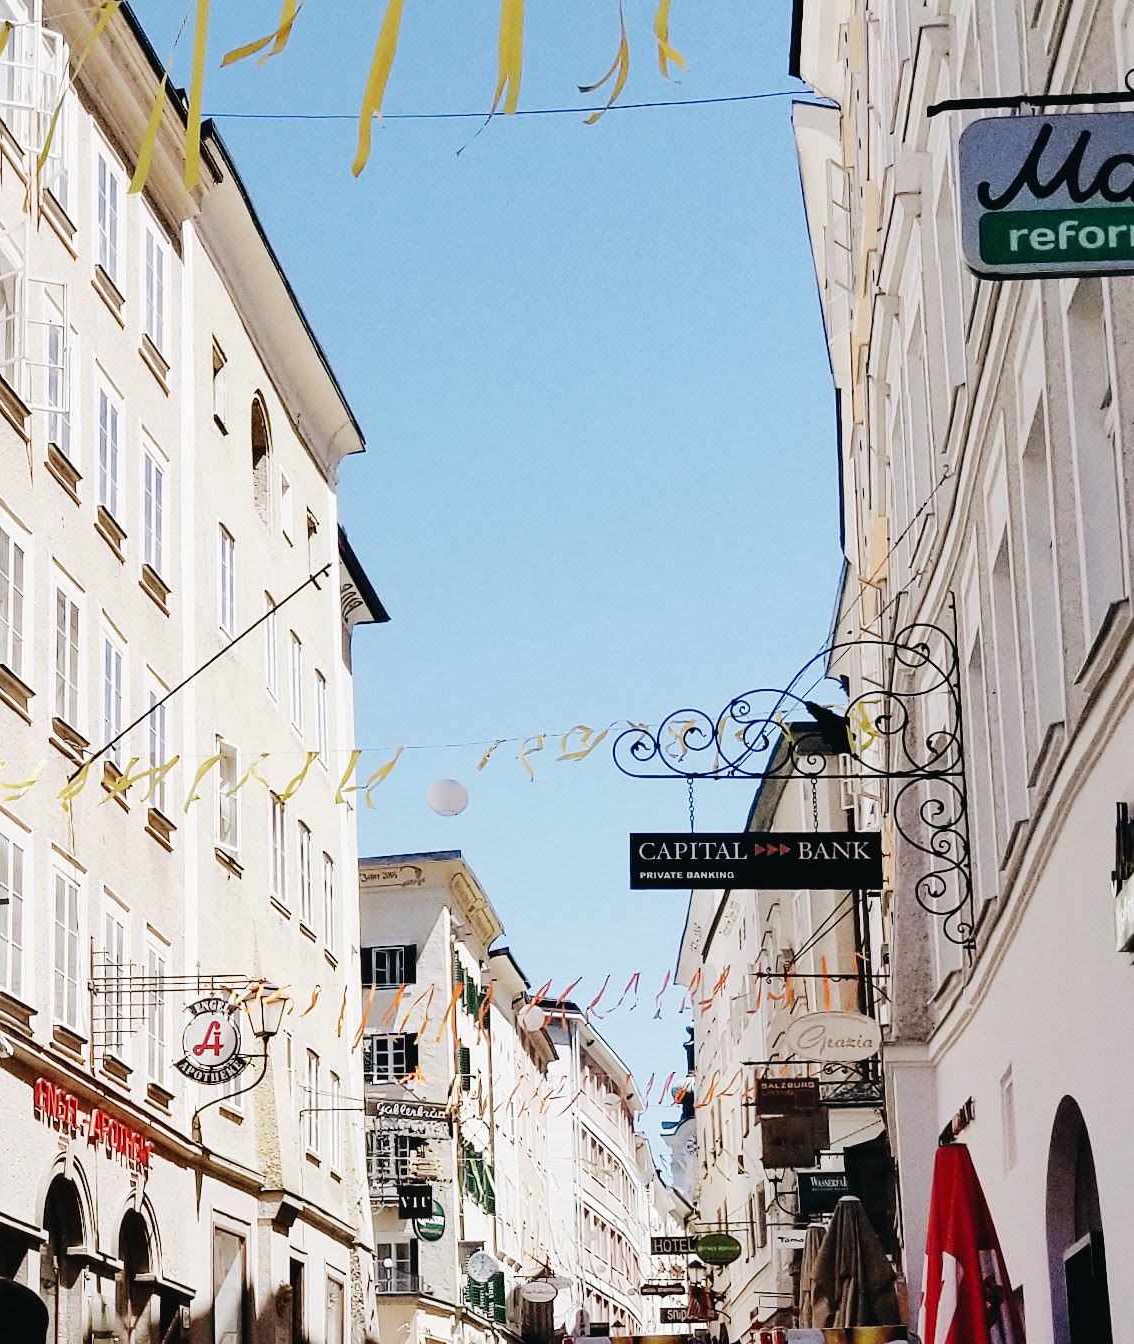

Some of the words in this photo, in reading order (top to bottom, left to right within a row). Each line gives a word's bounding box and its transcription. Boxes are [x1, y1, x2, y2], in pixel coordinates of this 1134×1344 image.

[638, 841, 748, 861] CAPITAL
[797, 841, 872, 860] BANK
[639, 871, 684, 880] PRIVATE
[686, 871, 735, 880] BANKING
[797, 1025, 874, 1056] Grazia
[178, 1058, 243, 1083] APOTHEKE
[761, 1081, 816, 1090] SALZBURG
[653, 1238, 695, 1253] HOTEL
[777, 1236, 805, 1244] Tama
